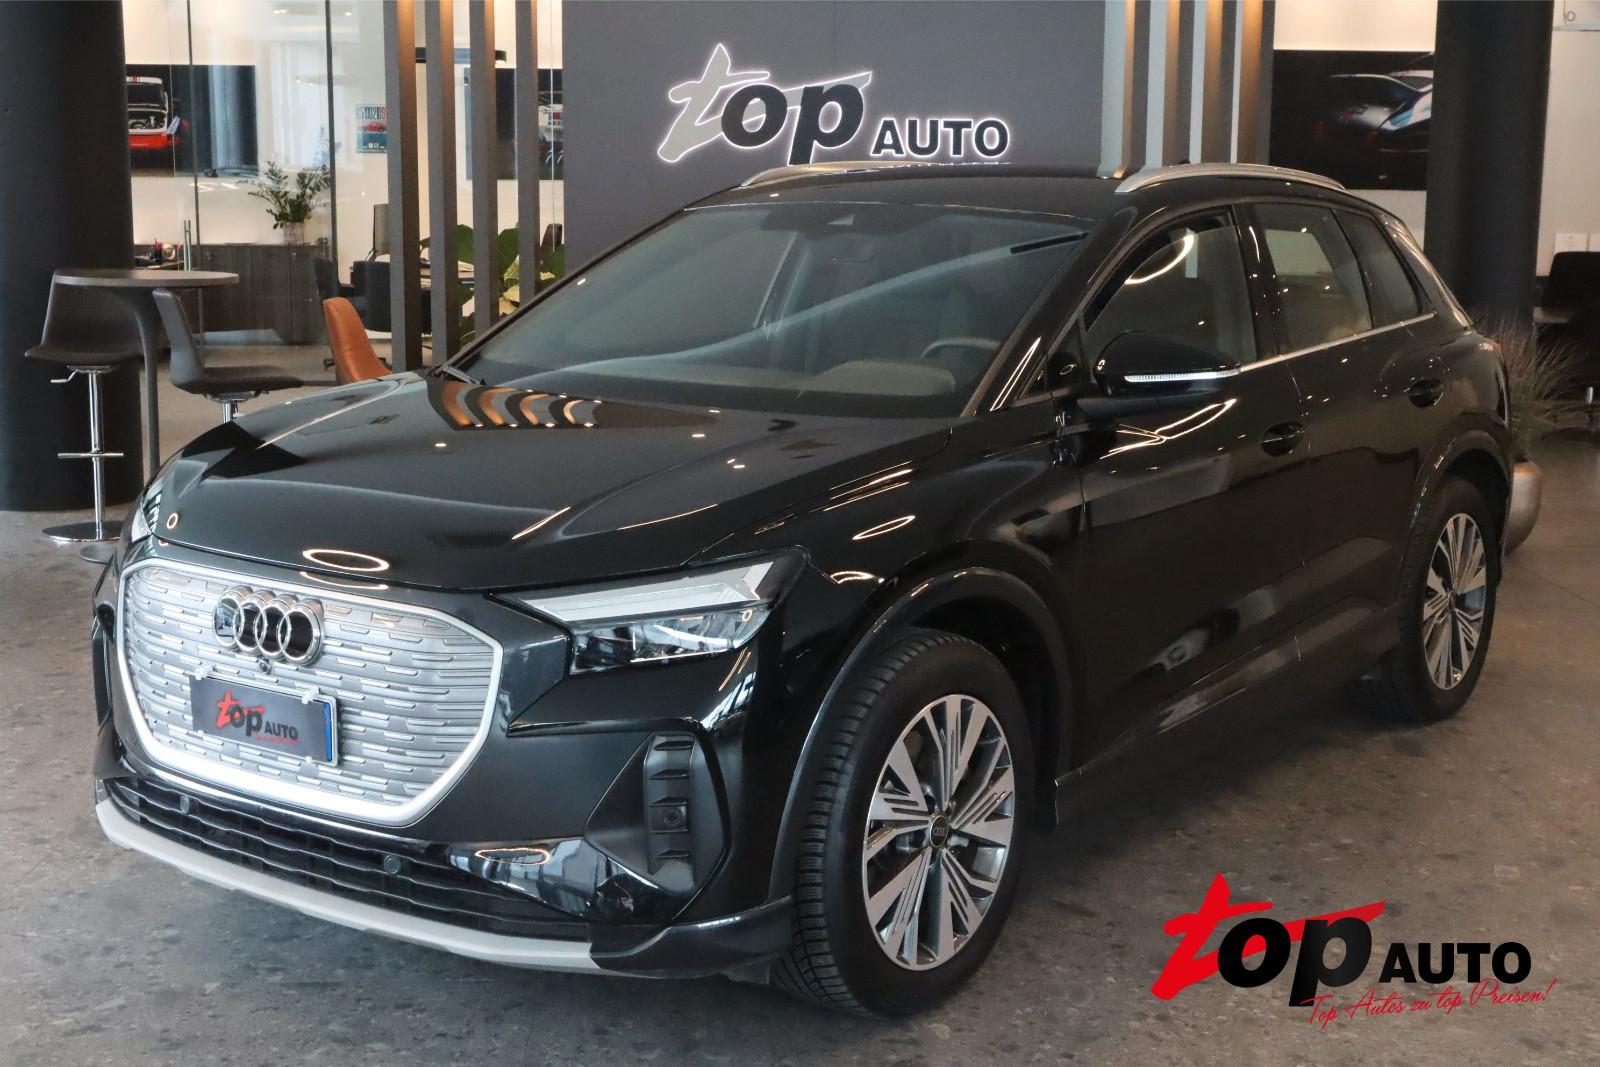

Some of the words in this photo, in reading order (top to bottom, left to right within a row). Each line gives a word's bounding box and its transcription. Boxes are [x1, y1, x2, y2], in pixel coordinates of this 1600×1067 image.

[657, 42, 873, 165] top
[870, 117, 1009, 158] AUTO
[216, 689, 265, 737] top
[264, 721, 299, 740] AUTO
